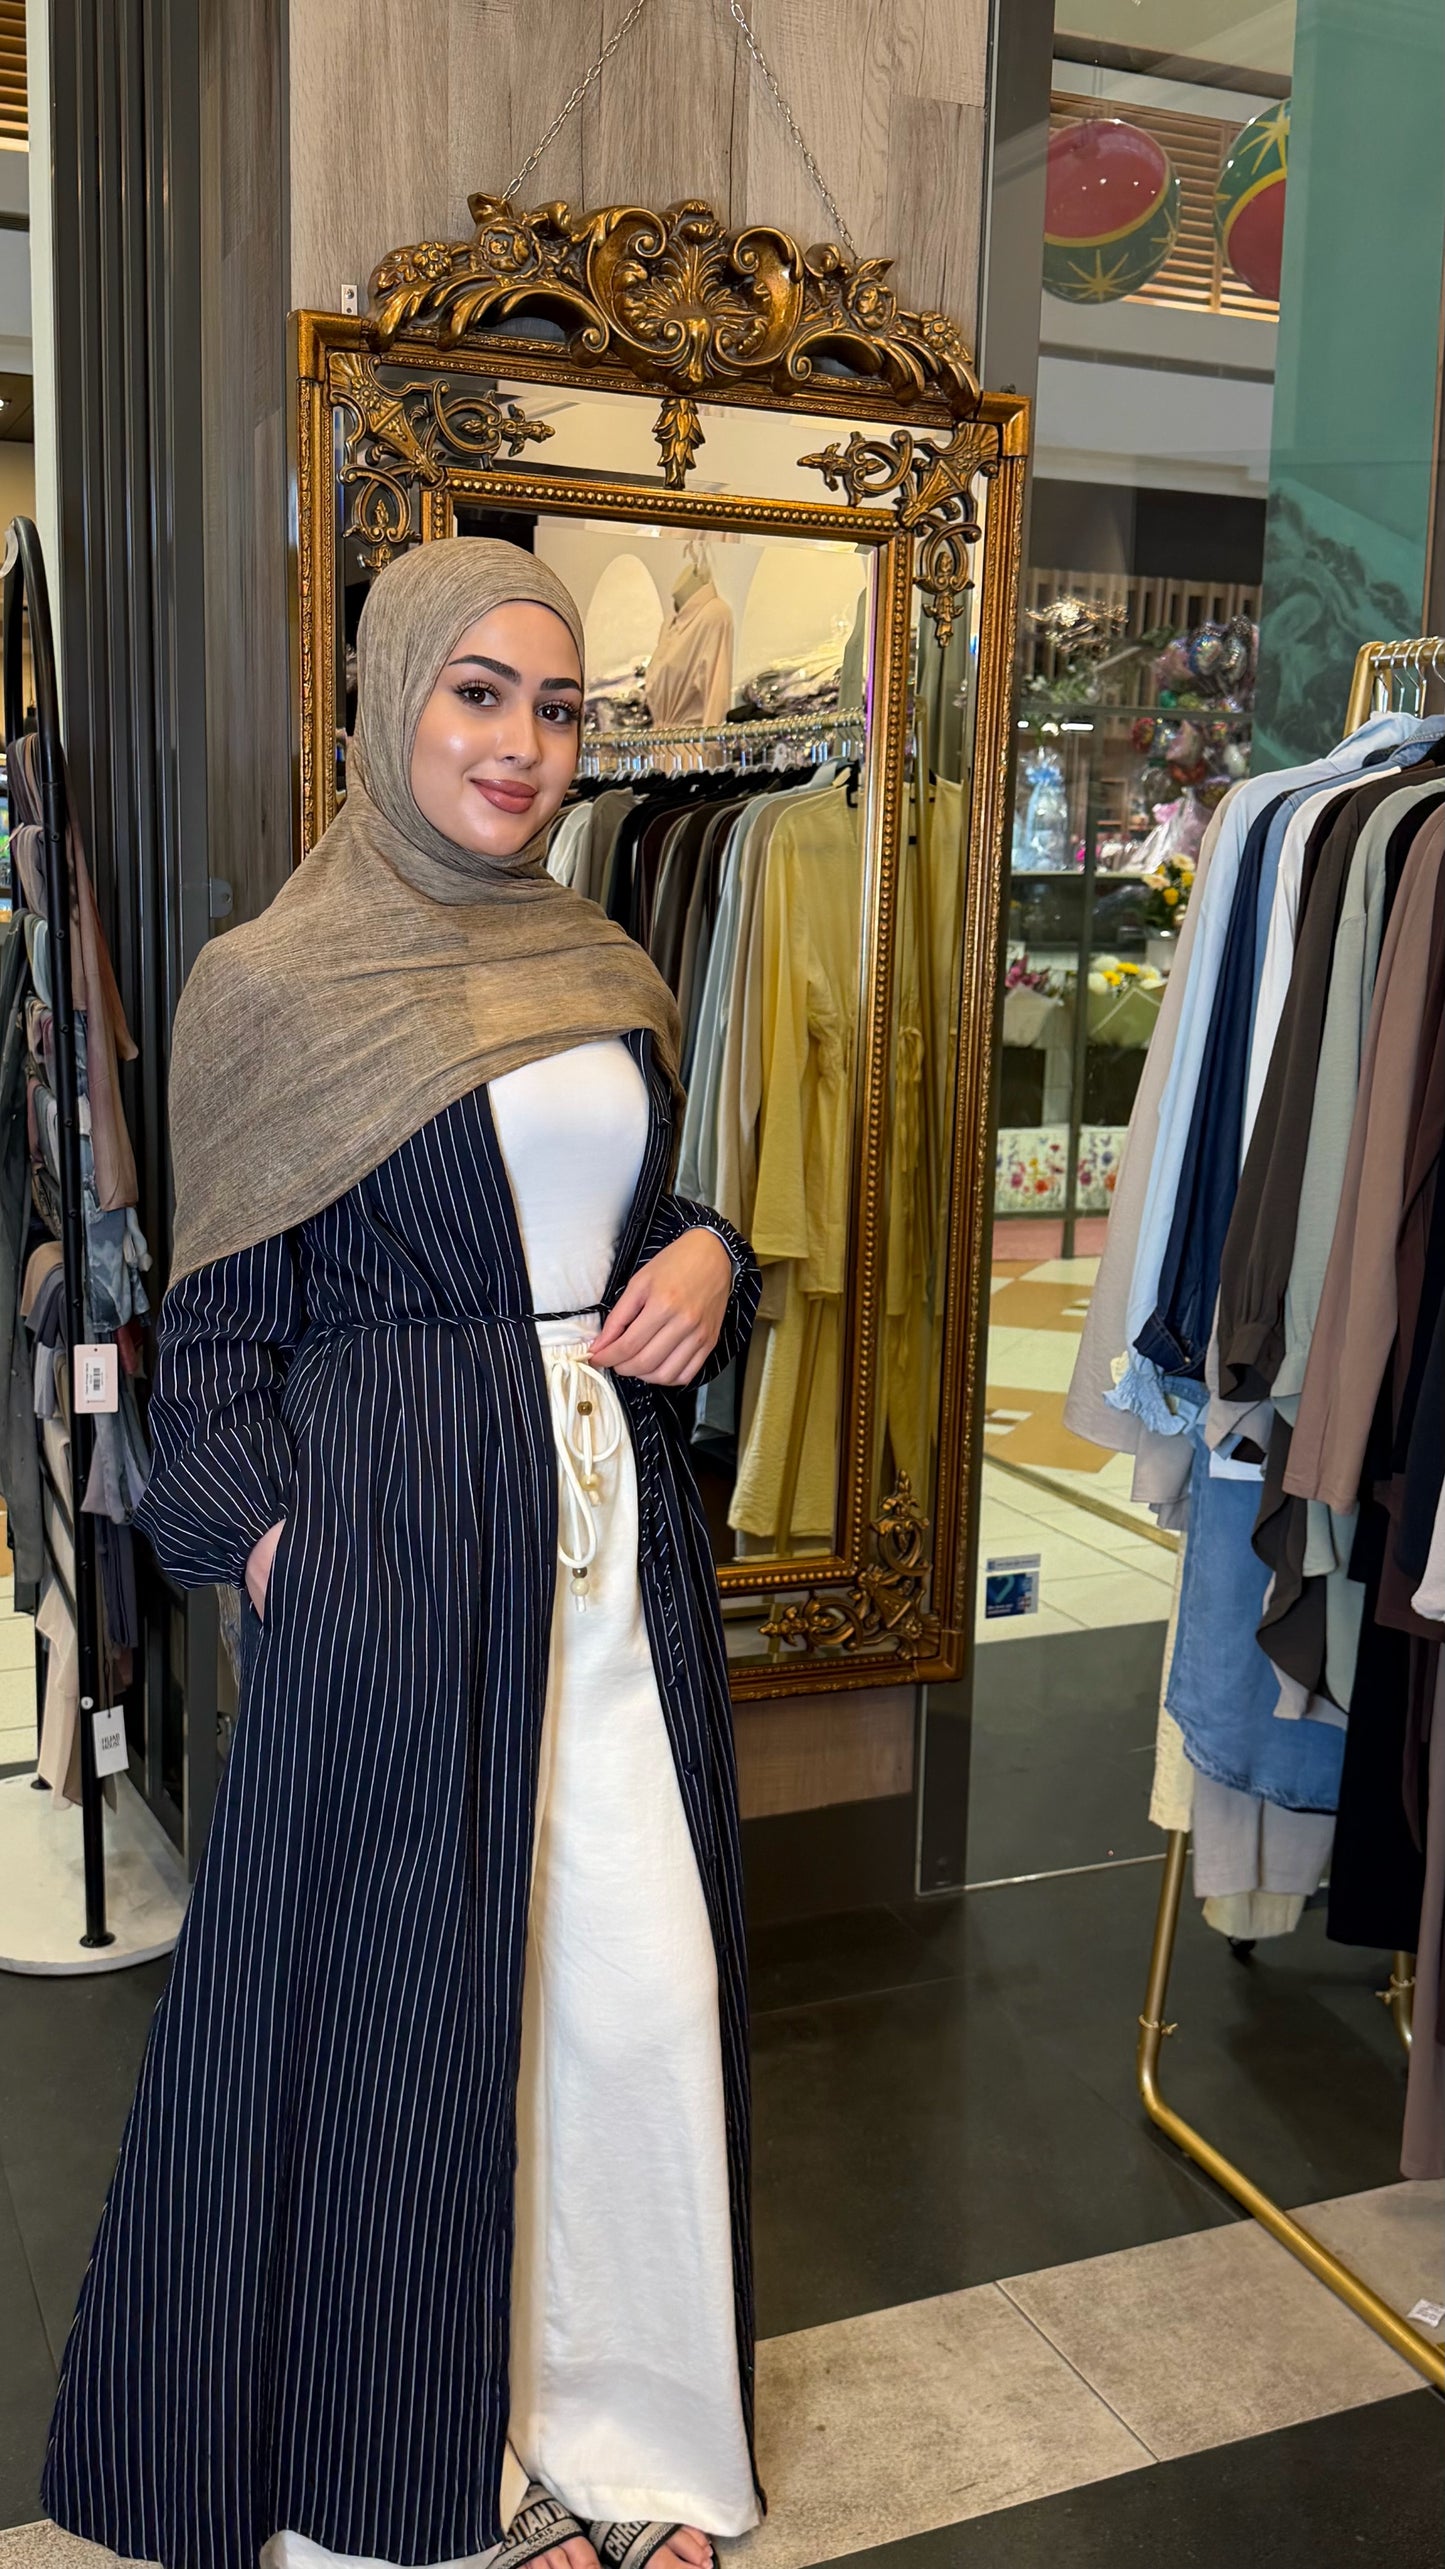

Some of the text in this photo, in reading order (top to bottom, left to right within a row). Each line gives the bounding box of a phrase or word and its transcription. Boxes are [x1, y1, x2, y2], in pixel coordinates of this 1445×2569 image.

[499, 2500, 571, 2552] STIAN D
[527, 2527, 554, 2546] PARIS
